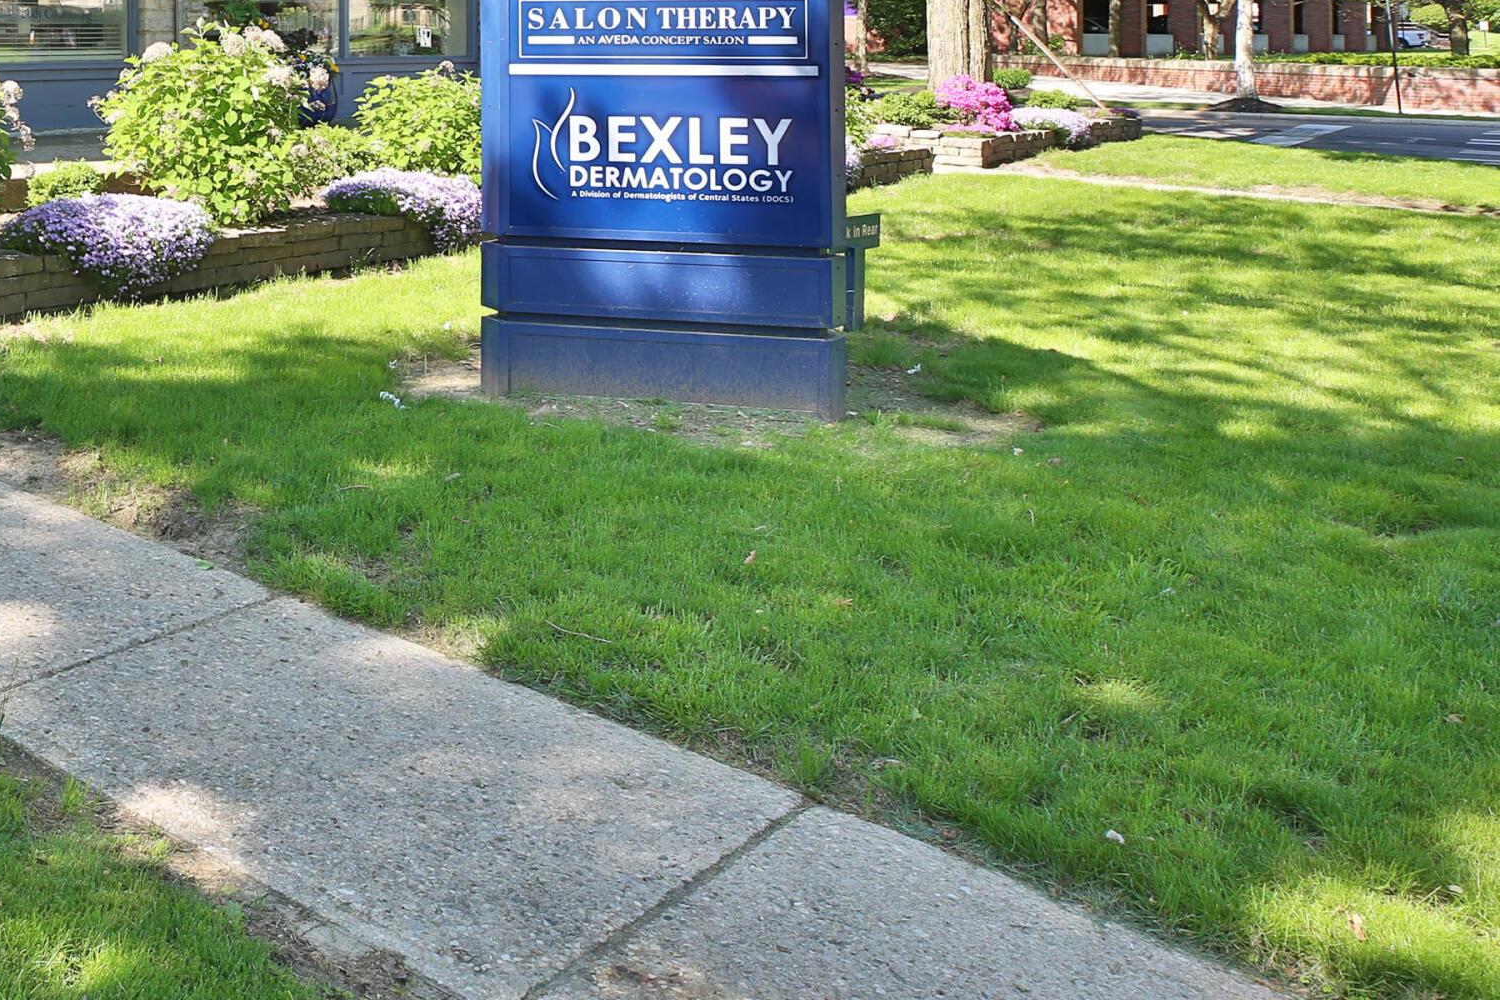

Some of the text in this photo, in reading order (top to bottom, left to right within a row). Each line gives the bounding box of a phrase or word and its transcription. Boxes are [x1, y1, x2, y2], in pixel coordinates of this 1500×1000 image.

[528, 6, 797, 30] SALON THERAPY
[577, 35, 745, 45] AN AVEDA CONCEPT SALON
[569, 114, 793, 166] BEXLEY
[569, 165, 793, 193] DERMATOLOGY
[571, 190, 794, 204] A Division of Dermatologists of Central States (DOCS)
[853, 225, 860, 238] in
[861, 224, 878, 237] Rear
